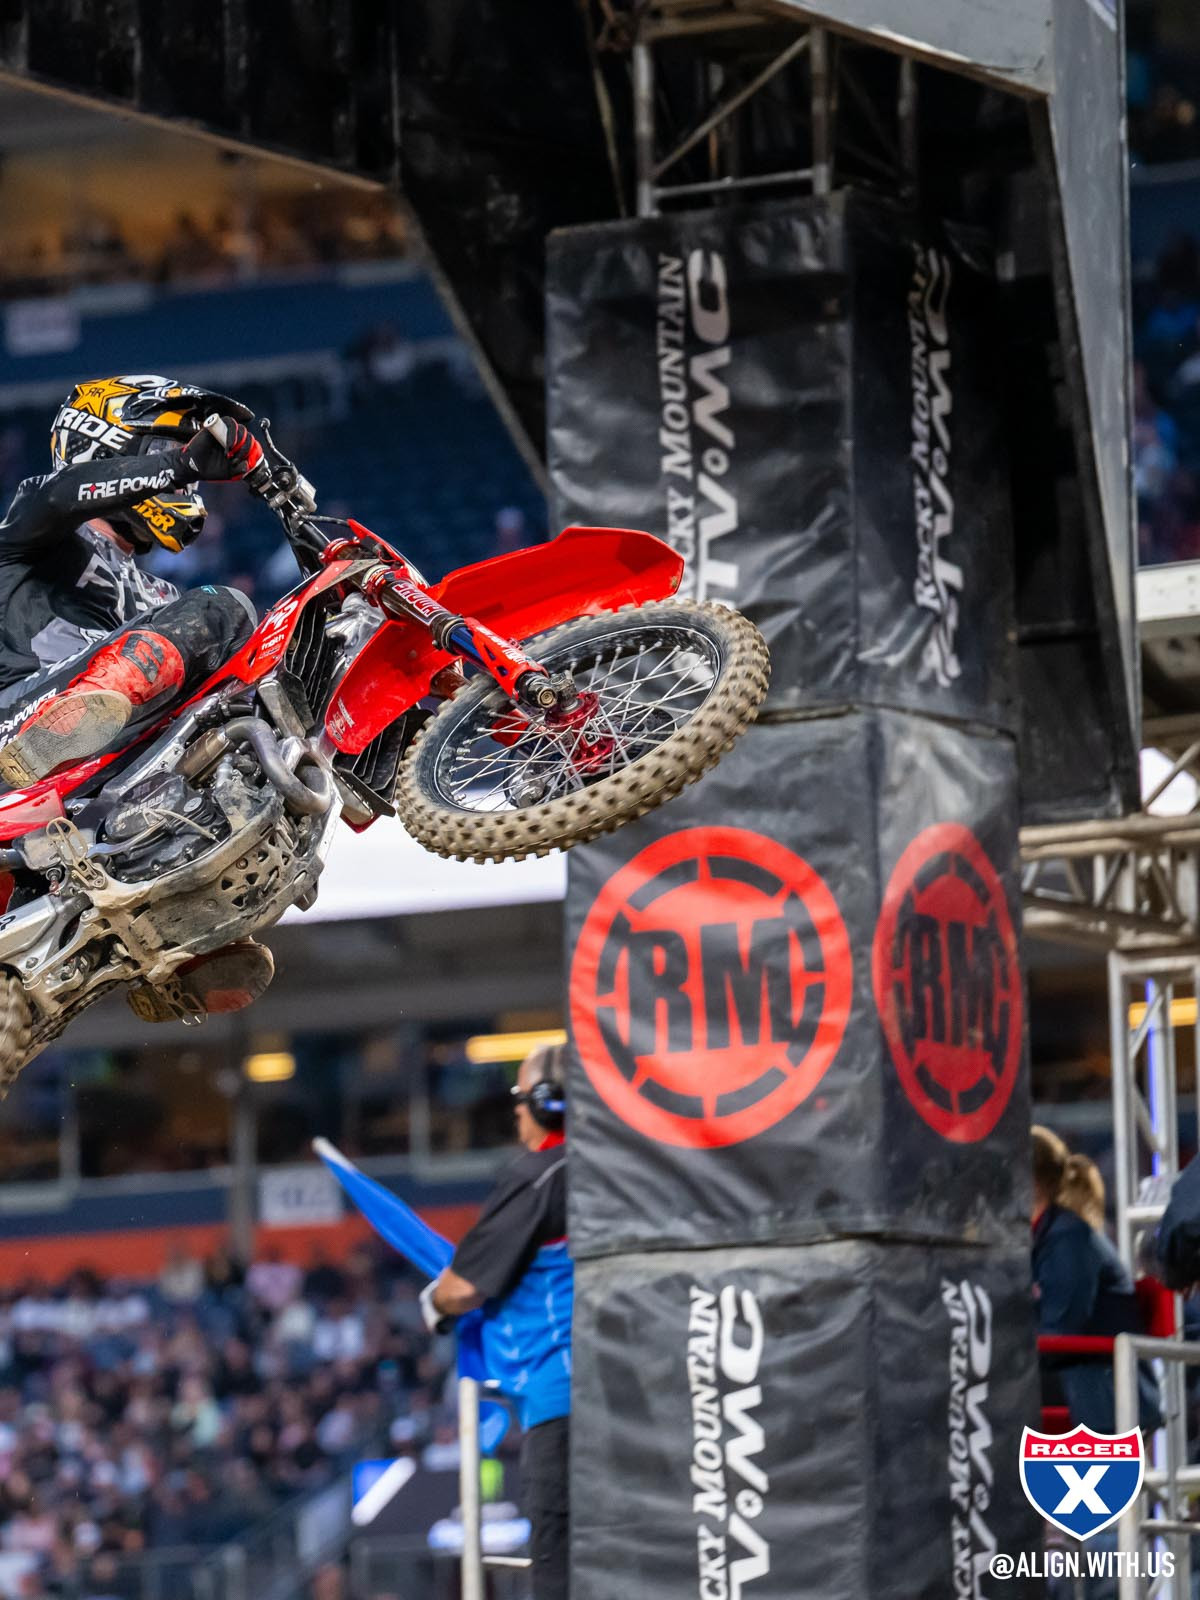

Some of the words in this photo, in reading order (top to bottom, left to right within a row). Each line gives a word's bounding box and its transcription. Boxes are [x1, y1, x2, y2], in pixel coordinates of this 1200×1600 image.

[55, 407, 134, 450] RIDE
[657, 253, 693, 480] MOUNTAIN
[913, 473, 943, 614] ROCKY
[687, 1285, 727, 1522] MOUNTAIN
[941, 1279, 971, 1512] MOUNTAIN
